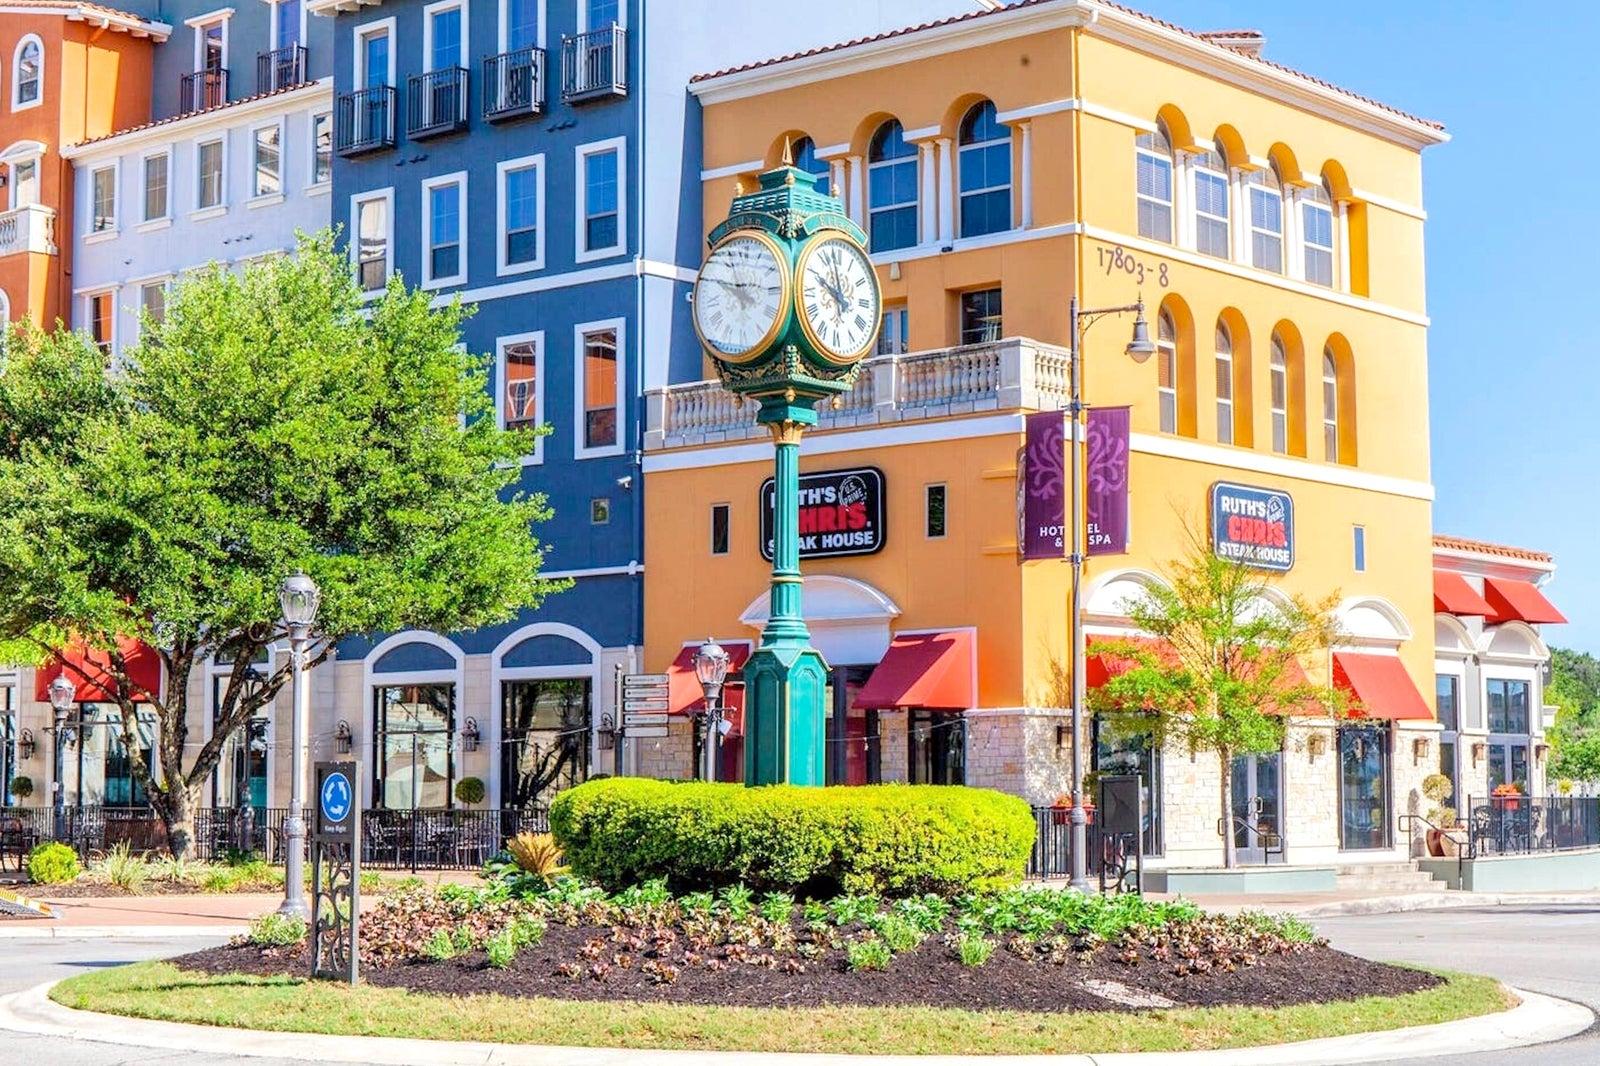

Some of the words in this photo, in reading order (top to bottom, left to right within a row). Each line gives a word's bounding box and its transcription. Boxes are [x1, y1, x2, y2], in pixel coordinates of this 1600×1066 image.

[1221, 496, 1267, 517] RUTH'S
[768, 535, 817, 553] SAK
[822, 531, 874, 548] HOUSE
[1088, 534, 1112, 546] SPA
[1255, 546, 1290, 563] HOUSE
